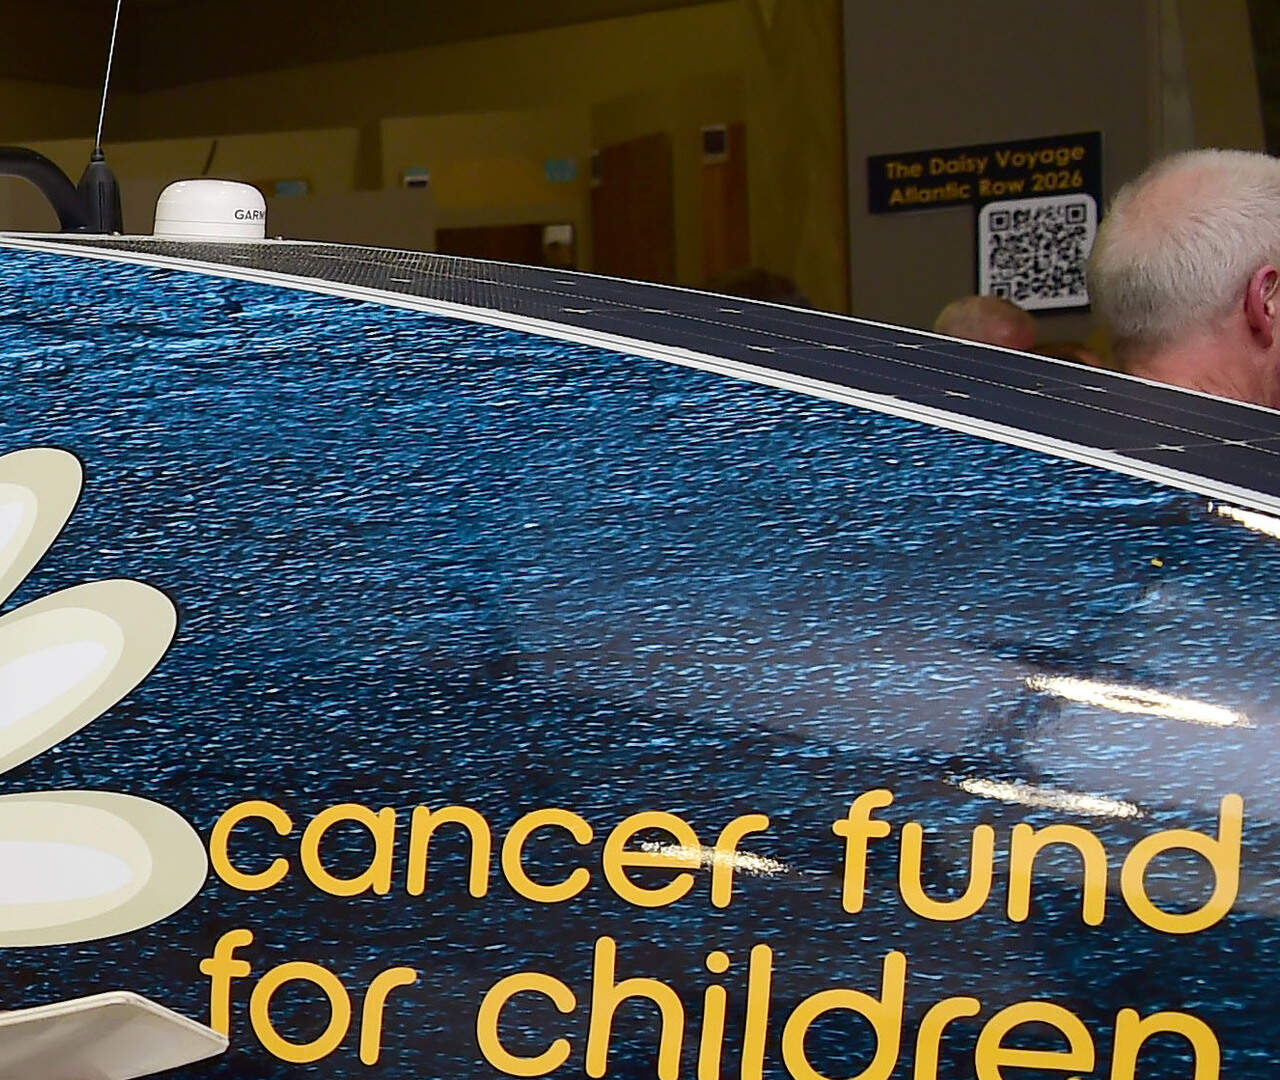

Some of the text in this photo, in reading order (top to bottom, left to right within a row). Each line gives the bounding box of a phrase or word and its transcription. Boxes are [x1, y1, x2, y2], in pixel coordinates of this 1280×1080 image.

[886, 145, 1085, 180] The Daisy Voyage
[889, 169, 1084, 204] Atlantic Row 2026
[234, 209, 265, 220] GARM
[209, 789, 1244, 935] cancer fund
[199, 928, 418, 1067] for
